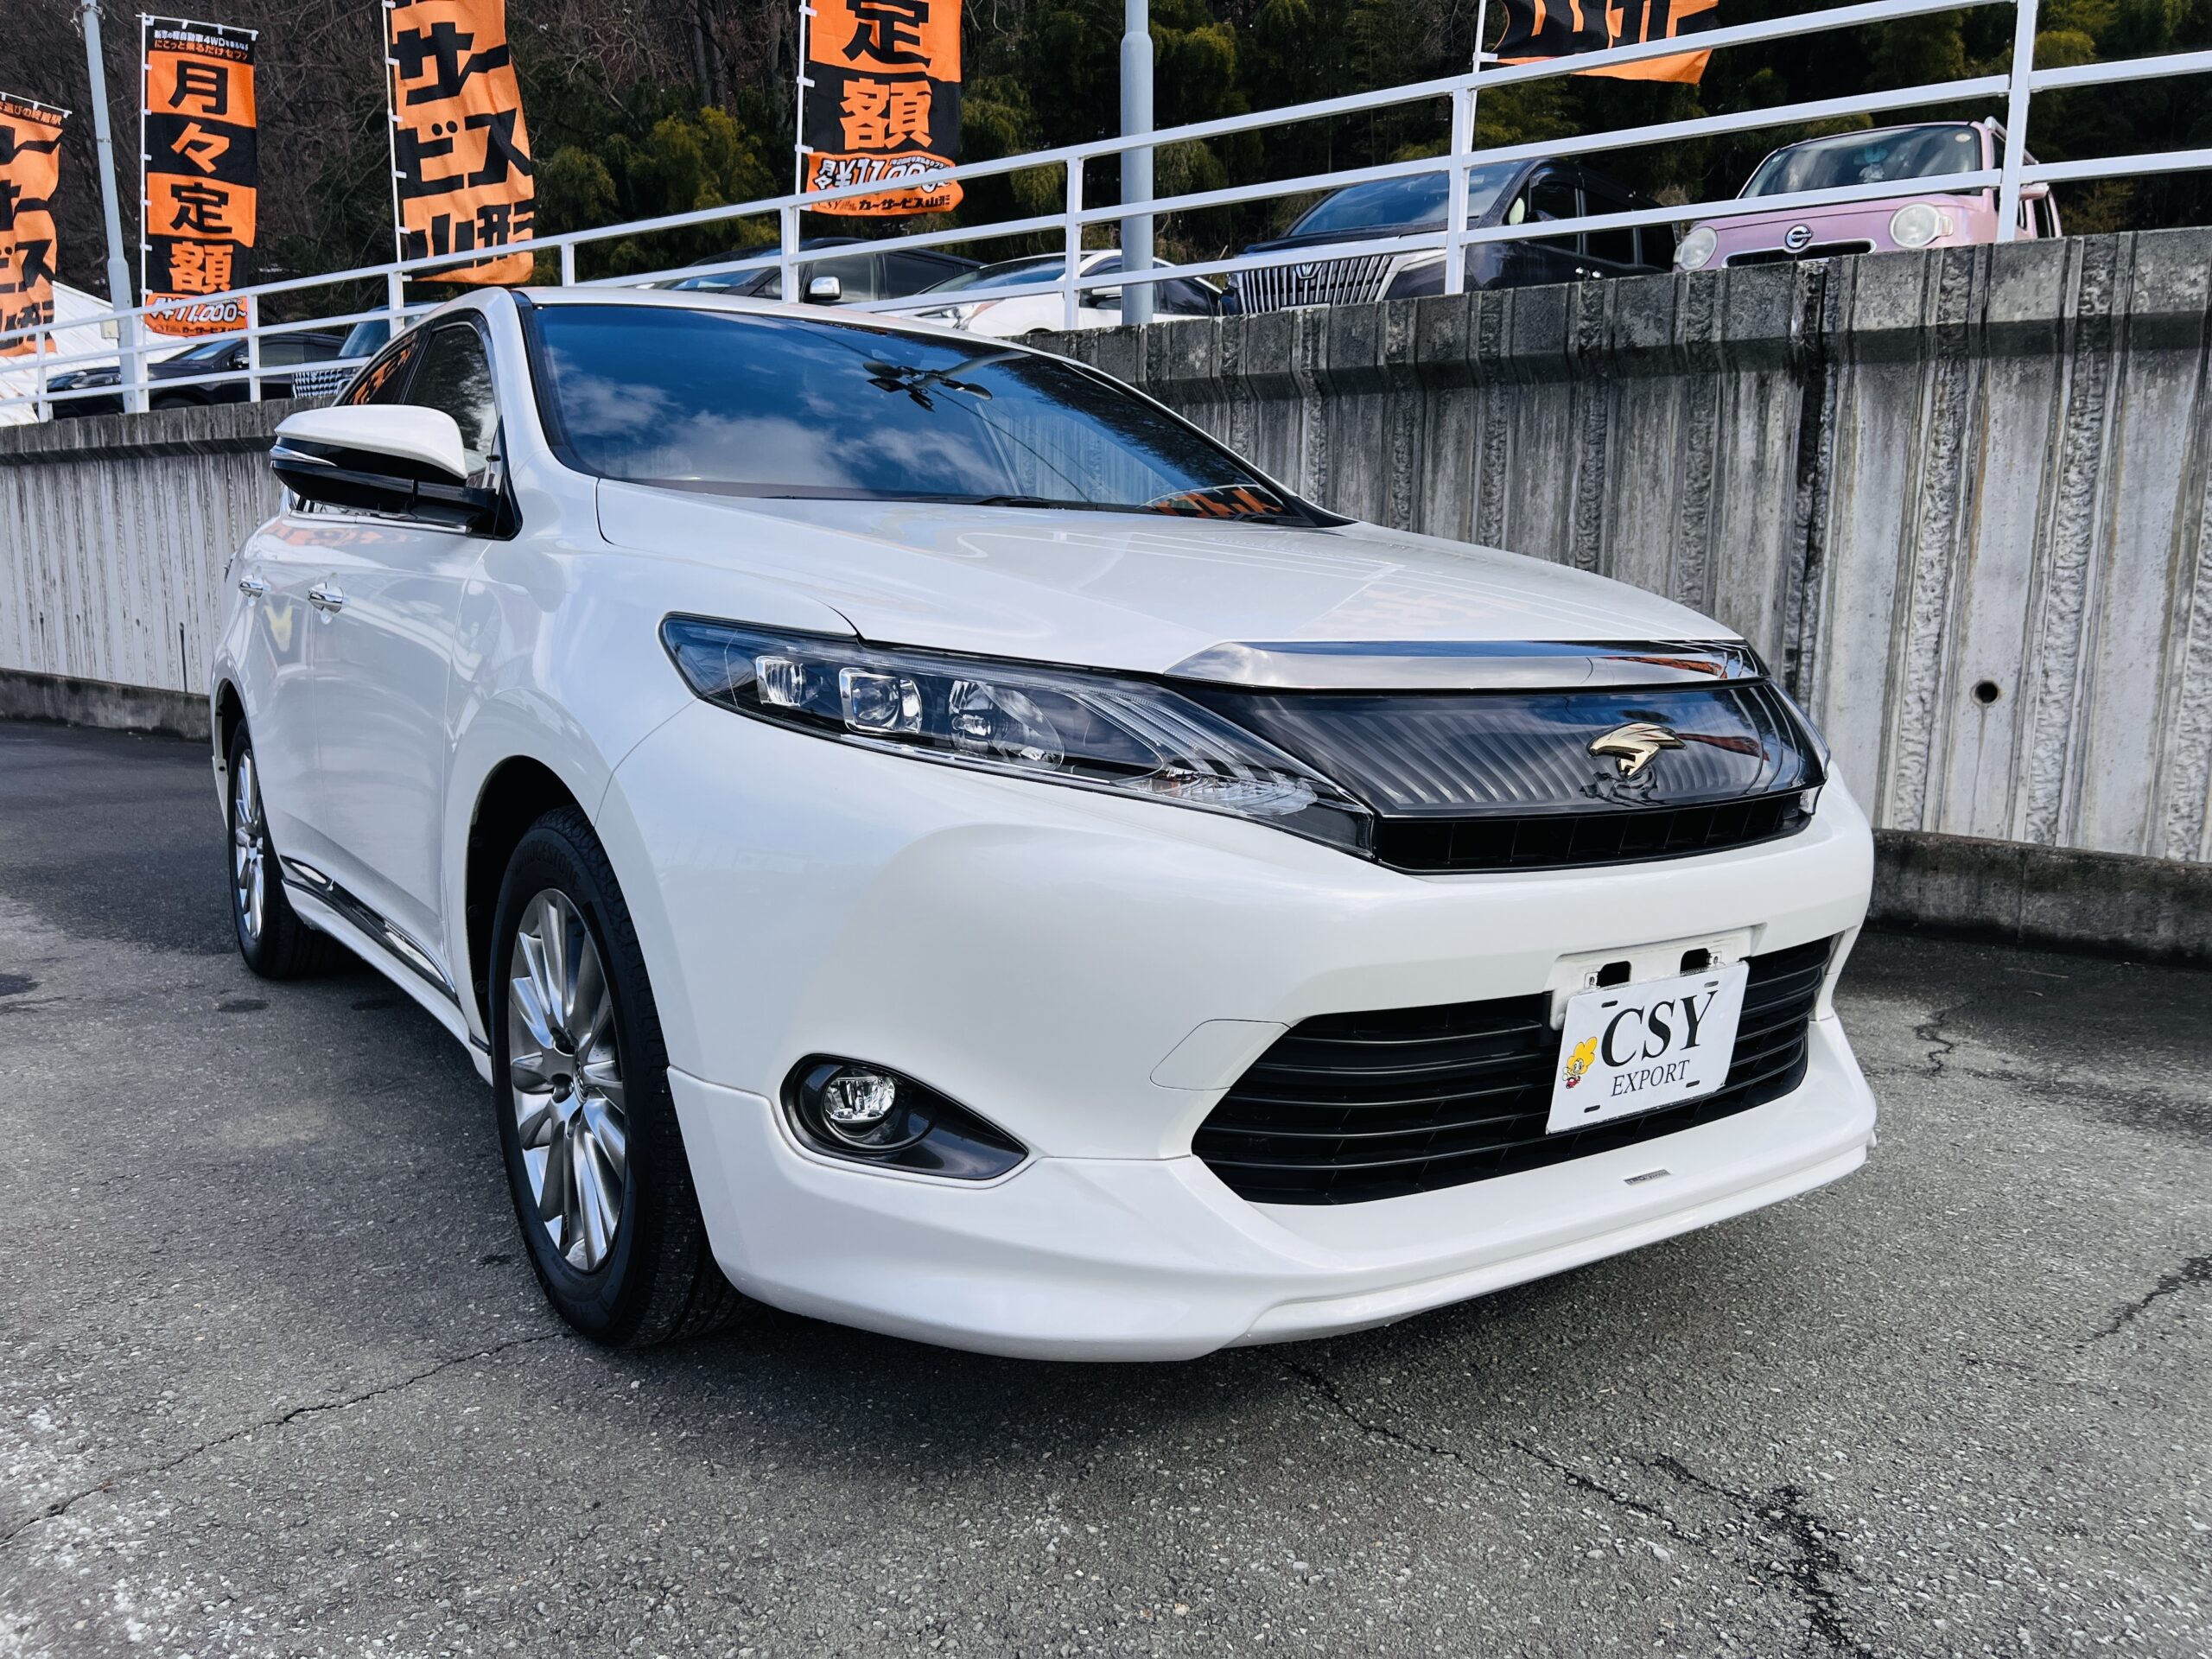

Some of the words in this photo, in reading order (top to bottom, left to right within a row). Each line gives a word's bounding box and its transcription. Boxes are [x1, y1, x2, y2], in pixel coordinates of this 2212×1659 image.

[168, 60, 236, 294] 月々定額
[858, 194, 951, 211] カーサービス山形
[1601, 989, 1719, 1068] CSY
[1611, 1059, 1690, 1097] EXPORT
